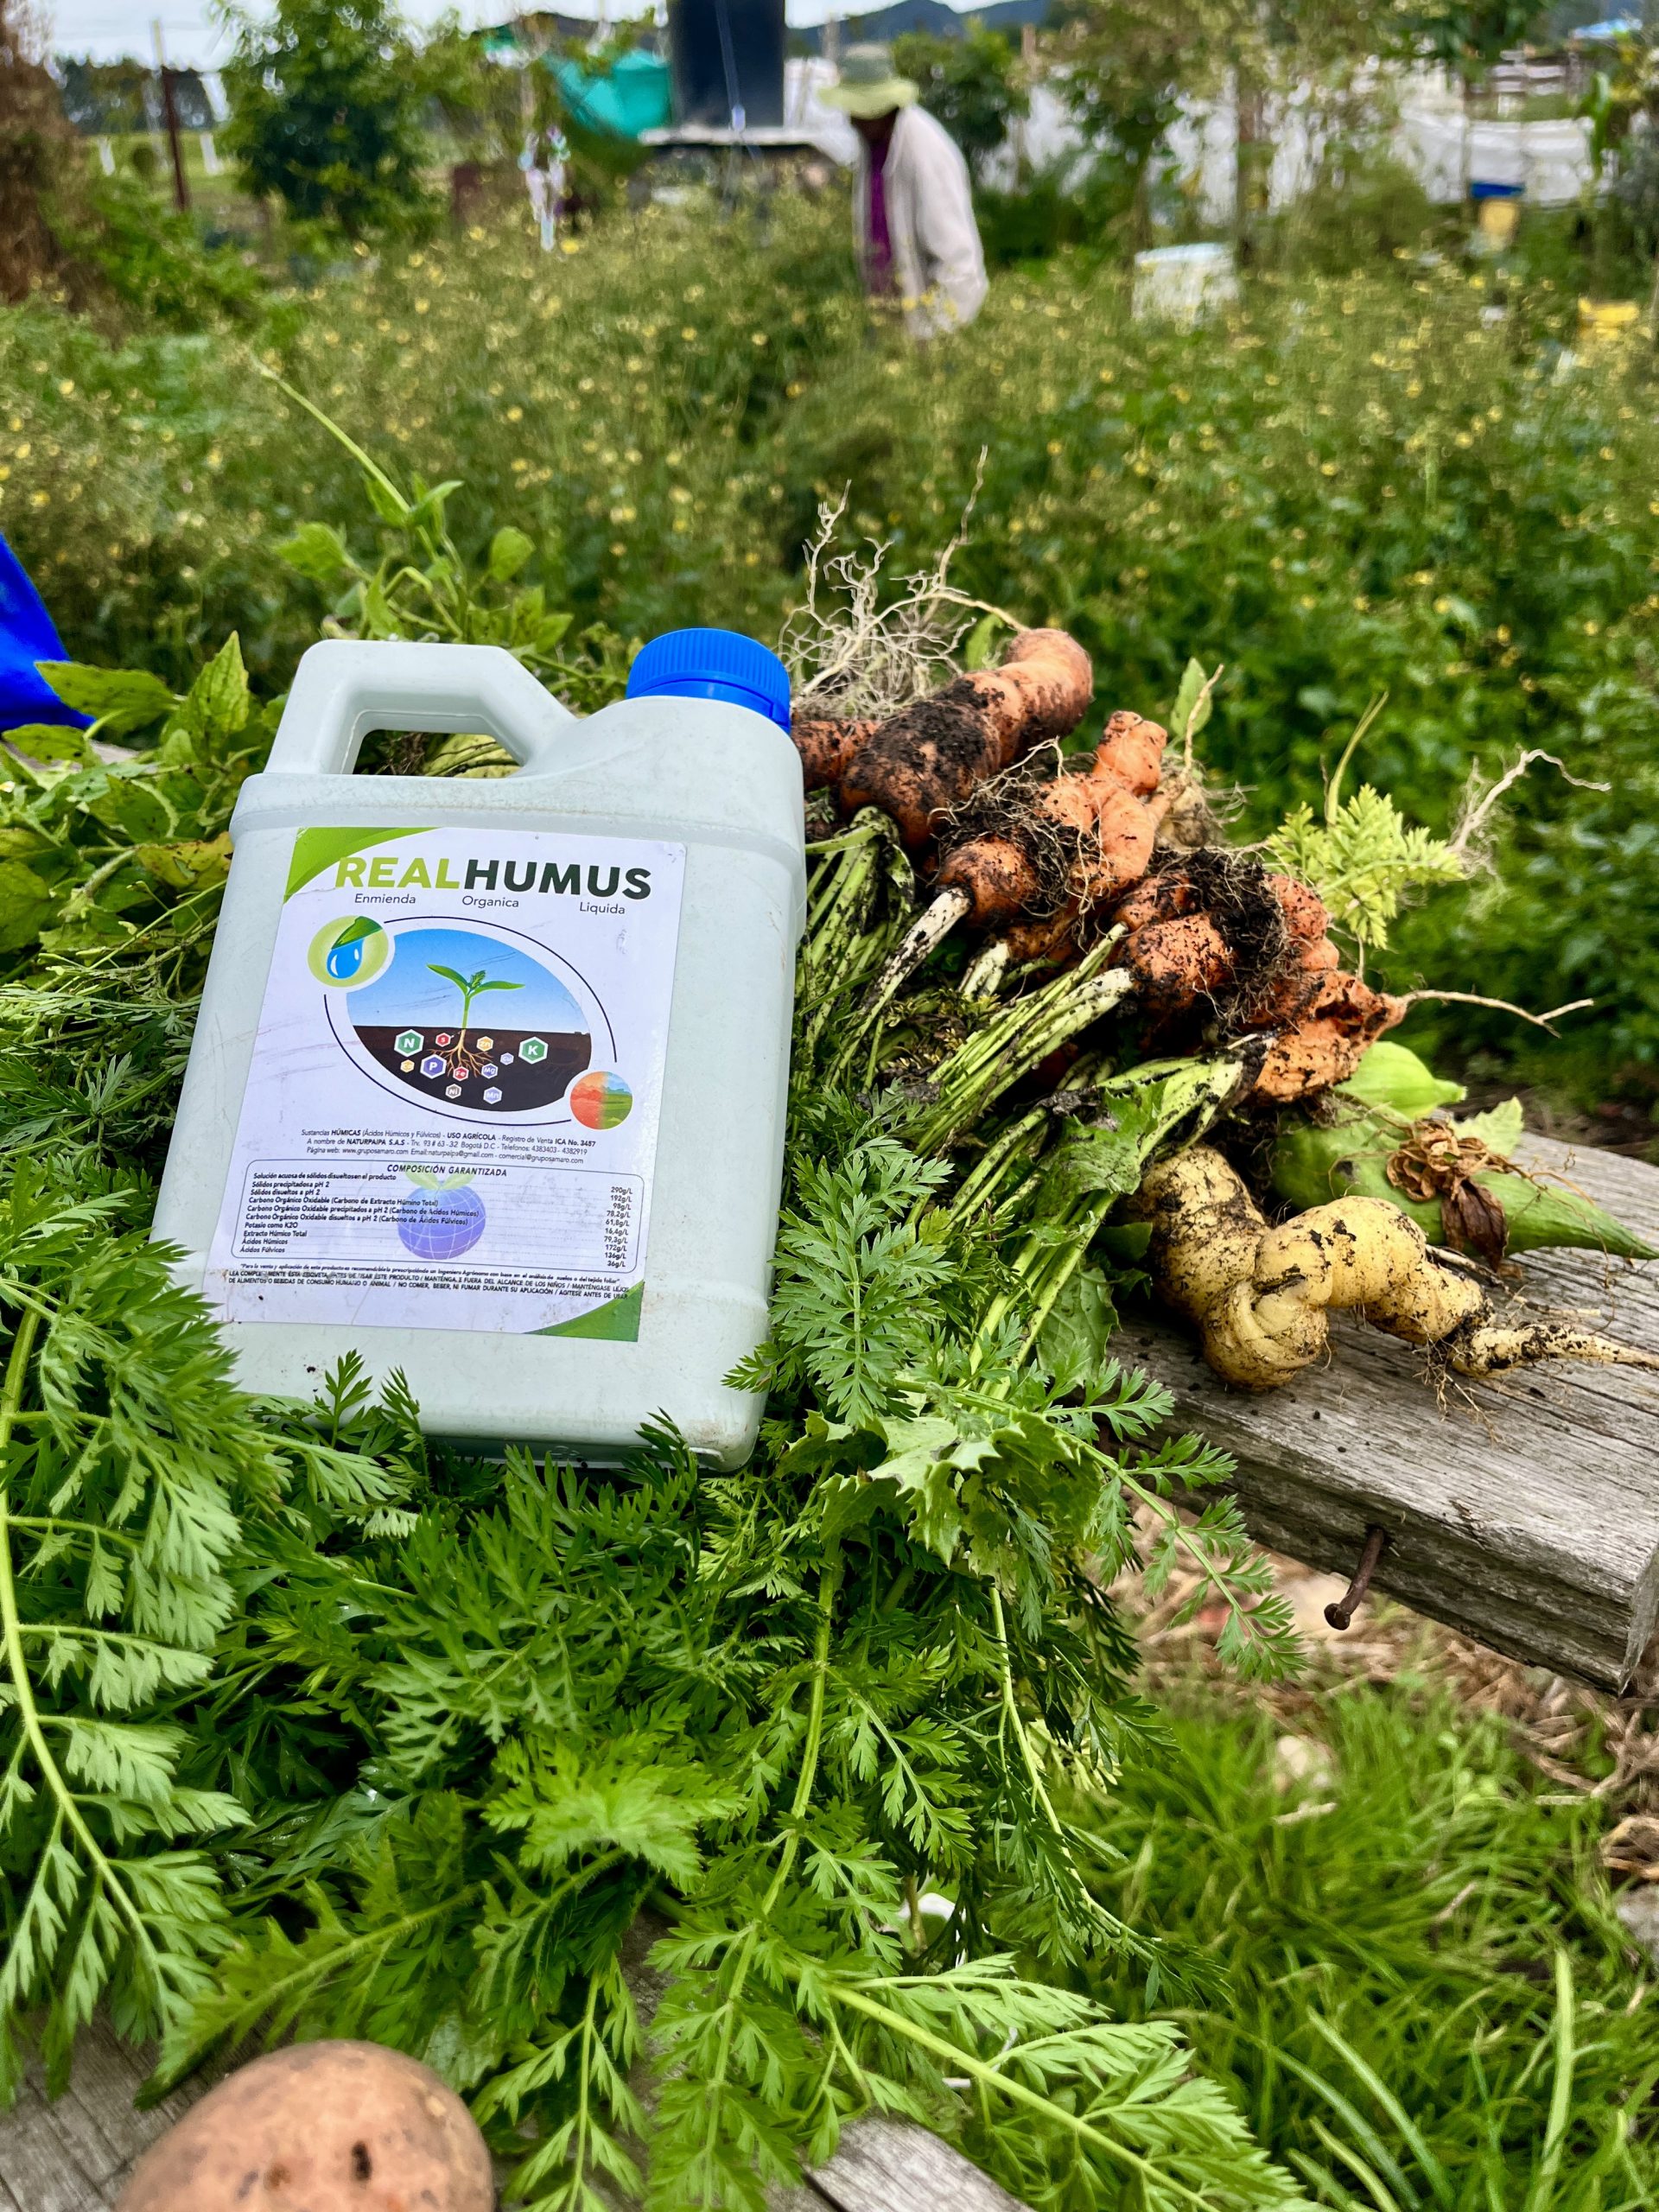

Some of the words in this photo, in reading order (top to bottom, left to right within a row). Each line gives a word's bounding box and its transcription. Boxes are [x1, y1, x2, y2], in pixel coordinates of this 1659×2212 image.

[355, 894, 416, 904] Enmienda
[462, 895, 519, 910] Organica
[579, 902, 625, 914] Liquida
[404, 1038, 415, 1048] N
[528, 1046, 538, 1055] K
[429, 1062, 437, 1070] P
[462, 1132, 496, 1140] AGRÍCOLA
[387, 1165, 445, 1173] COMPOSICIÓN
[448, 1167, 507, 1176] GARANTIZADA
[611, 1187, 632, 1195] 290g/L
